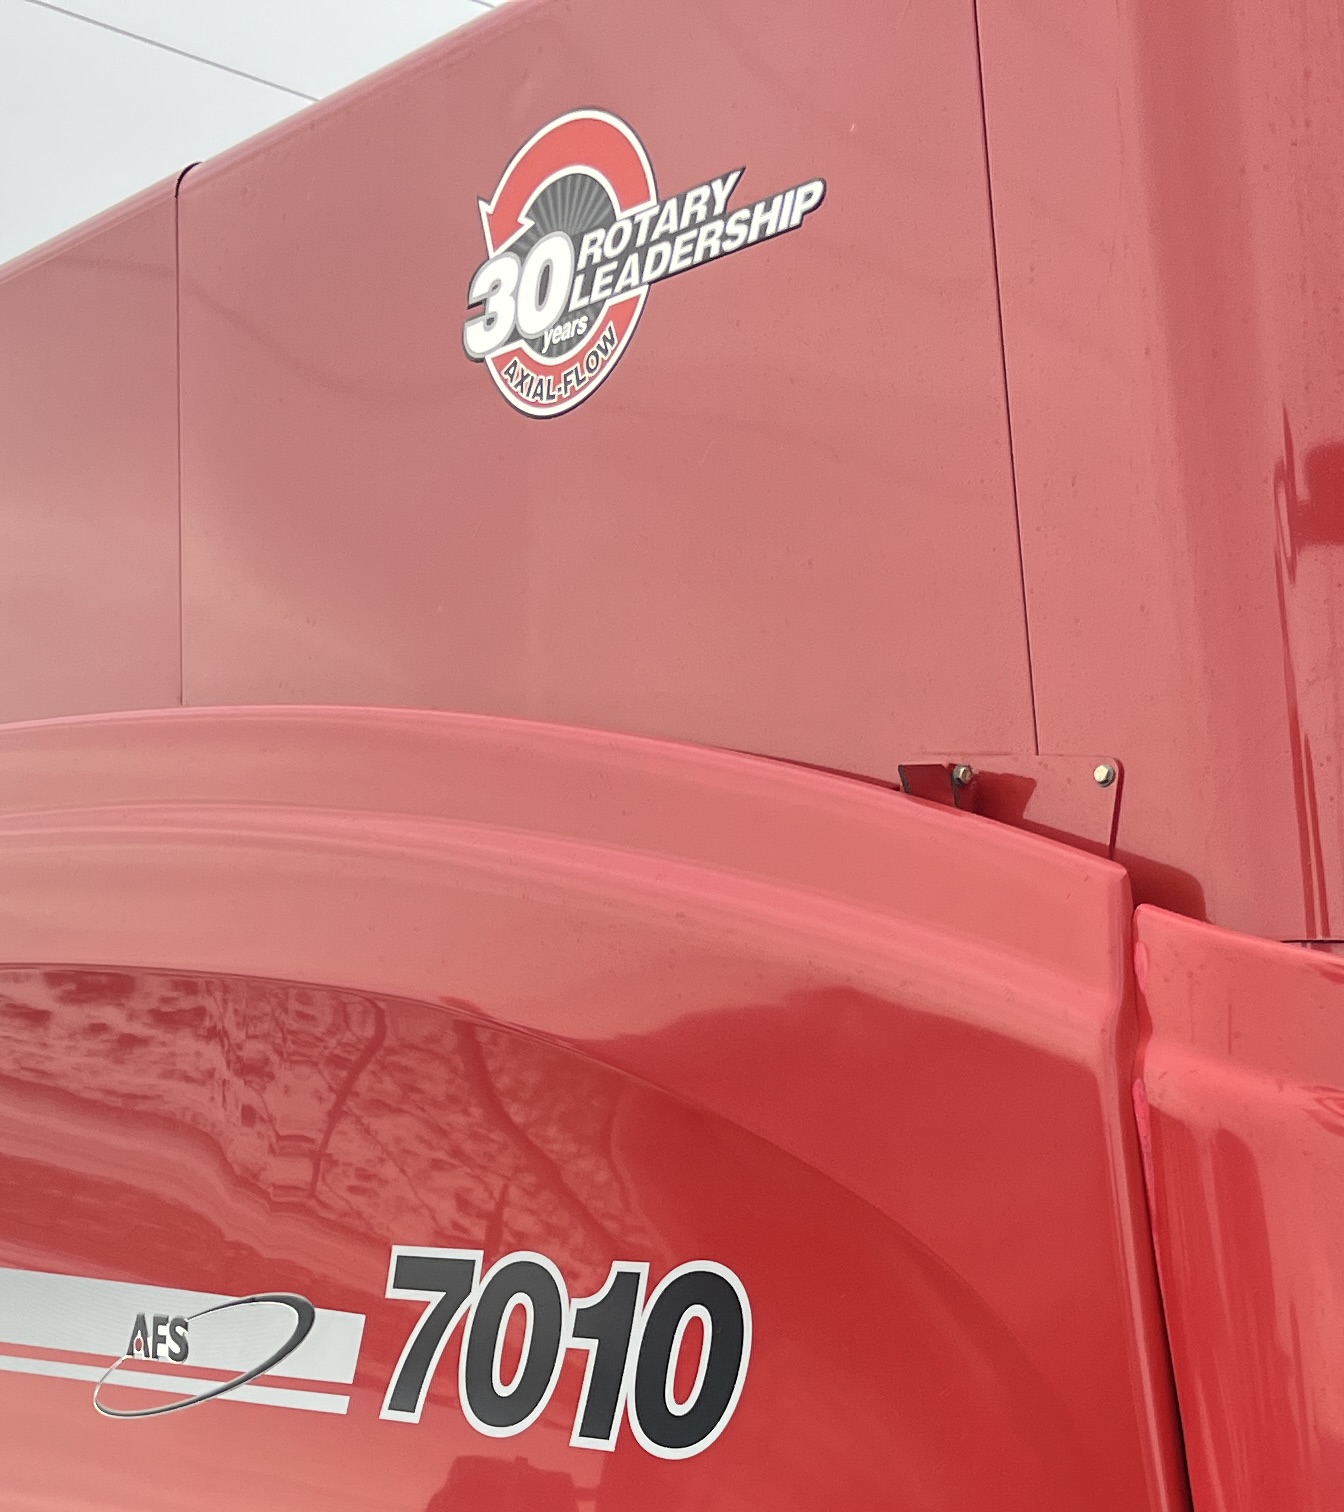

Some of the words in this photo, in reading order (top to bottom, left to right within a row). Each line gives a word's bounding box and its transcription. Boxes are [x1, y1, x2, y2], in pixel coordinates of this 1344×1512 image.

[569, 179, 824, 312] LEADERSHIP
[577, 168, 743, 271] ROTARY
[463, 231, 575, 360] 30
[541, 313, 589, 354] years
[501, 324, 618, 405] AXIAL-FLOW
[125, 1311, 191, 1365] AFS
[378, 1244, 753, 1461] 7010
